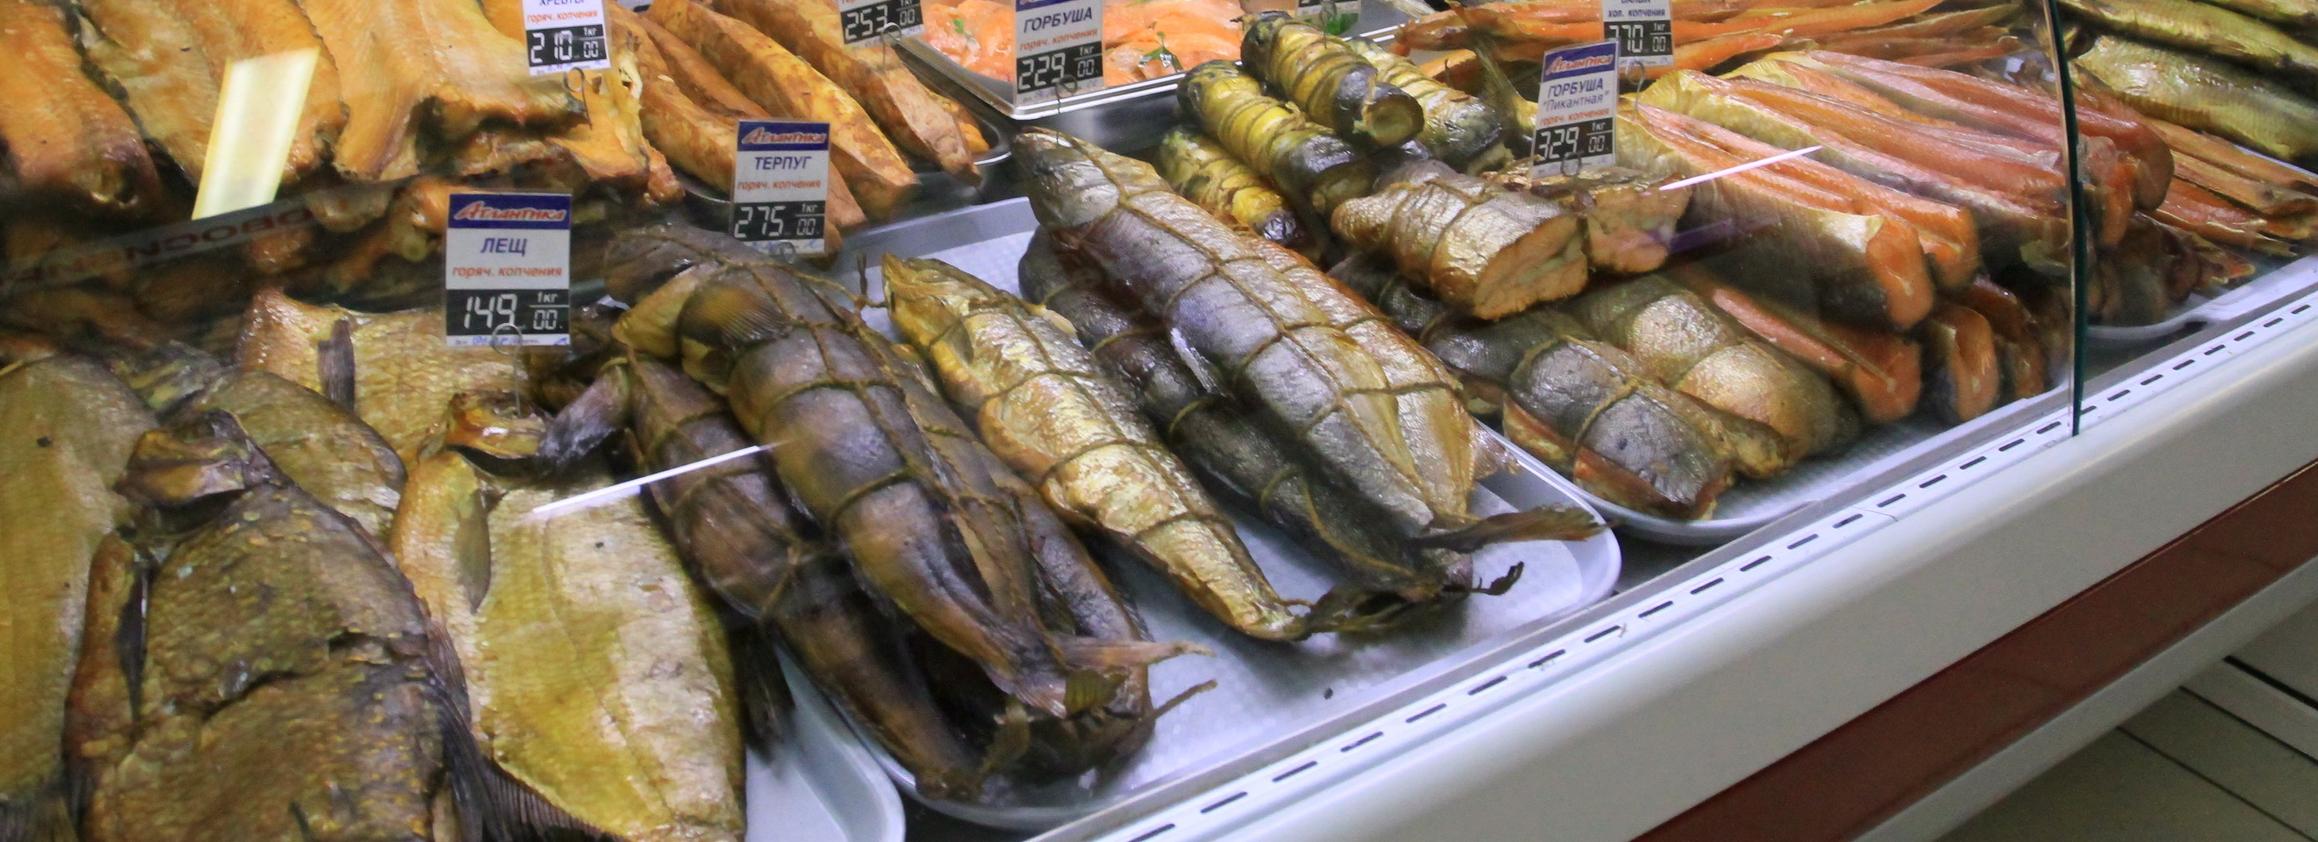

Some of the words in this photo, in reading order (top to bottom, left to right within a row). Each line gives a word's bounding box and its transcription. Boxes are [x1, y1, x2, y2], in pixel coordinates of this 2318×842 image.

[845, 4, 888, 40] 253
[900, 8, 915, 26] 00
[1023, 7, 1092, 33] ГОРБУША
[531, 30, 572, 63] 210
[584, 41, 599, 58] 00
[1652, 36, 1666, 52] 00
[1018, 52, 1066, 90] 229
[1077, 59, 1094, 78] 00
[1545, 54, 1614, 76] Атлантика
[1547, 78, 1603, 98] ГОРБУША
[1538, 126, 1580, 161] 329
[1588, 135, 1605, 153] 00
[755, 156, 812, 170] ТЕРПУГ
[454, 201, 567, 221] Атлантика
[734, 206, 786, 238] 275
[796, 218, 816, 236] 00
[480, 238, 528, 257] ЛЕЩ
[453, 267, 495, 279] горяч.
[499, 267, 562, 277] копчения
[537, 292, 558, 303] 1кг
[464, 294, 517, 330] 149
[533, 310, 558, 330] 00
